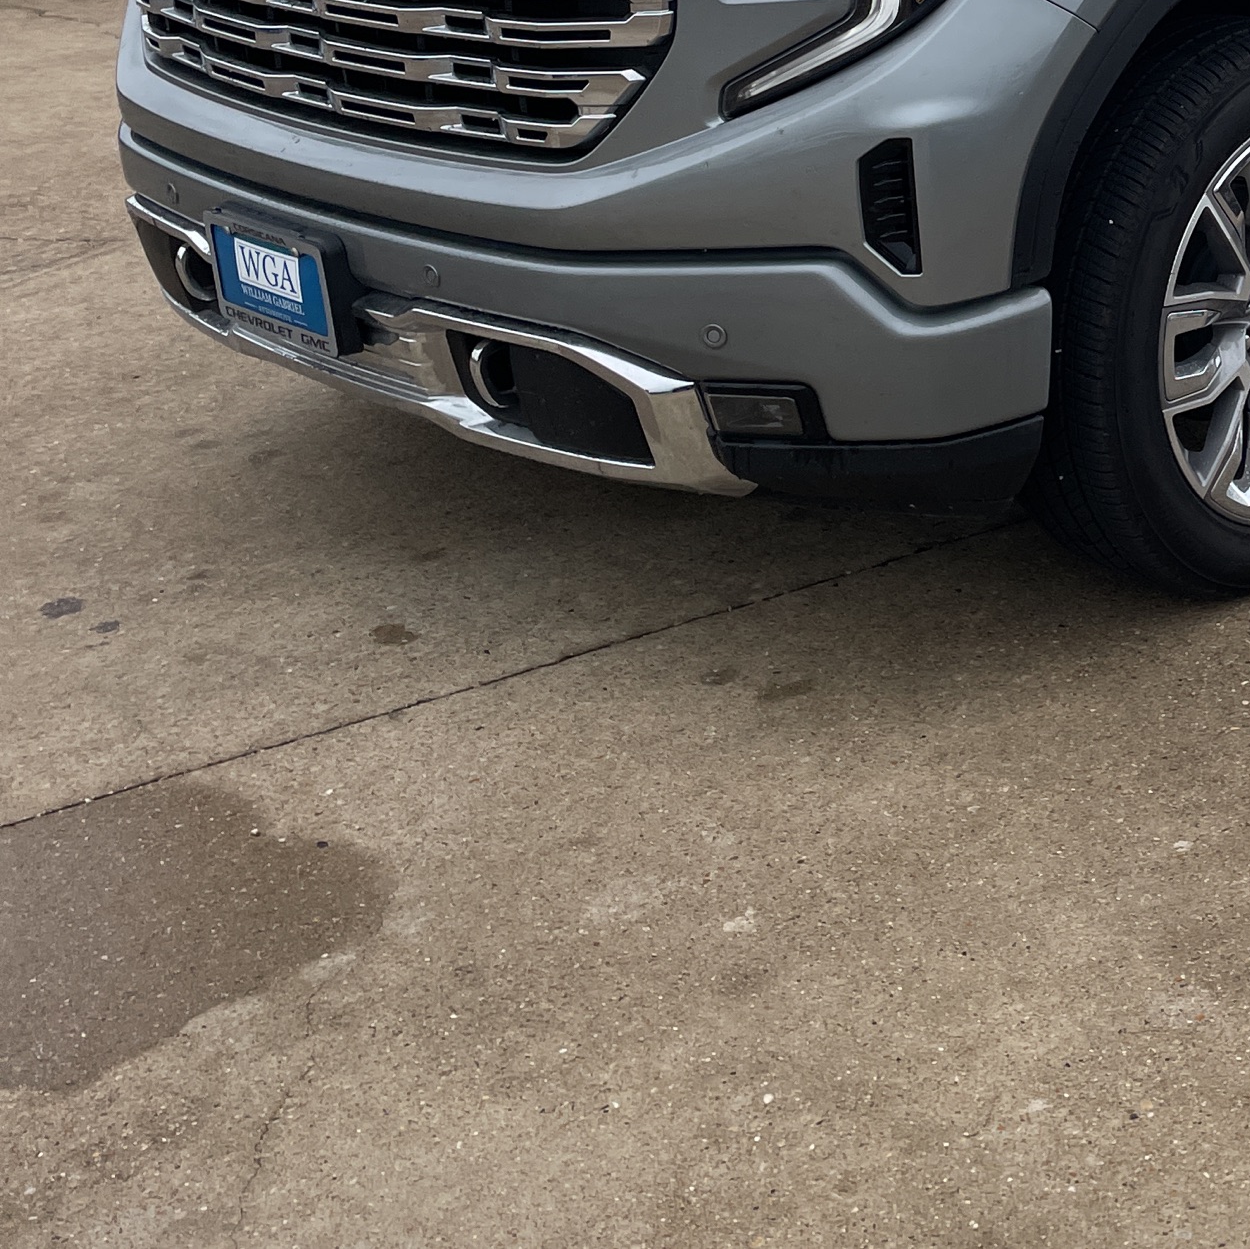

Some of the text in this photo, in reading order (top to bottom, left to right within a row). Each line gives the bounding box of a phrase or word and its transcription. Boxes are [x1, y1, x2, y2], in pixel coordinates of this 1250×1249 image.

[239, 244, 298, 295] WGA
[240, 283, 306, 316] WILLIAM GABRIEL
[225, 305, 331, 352] CHEVROLET GMC
